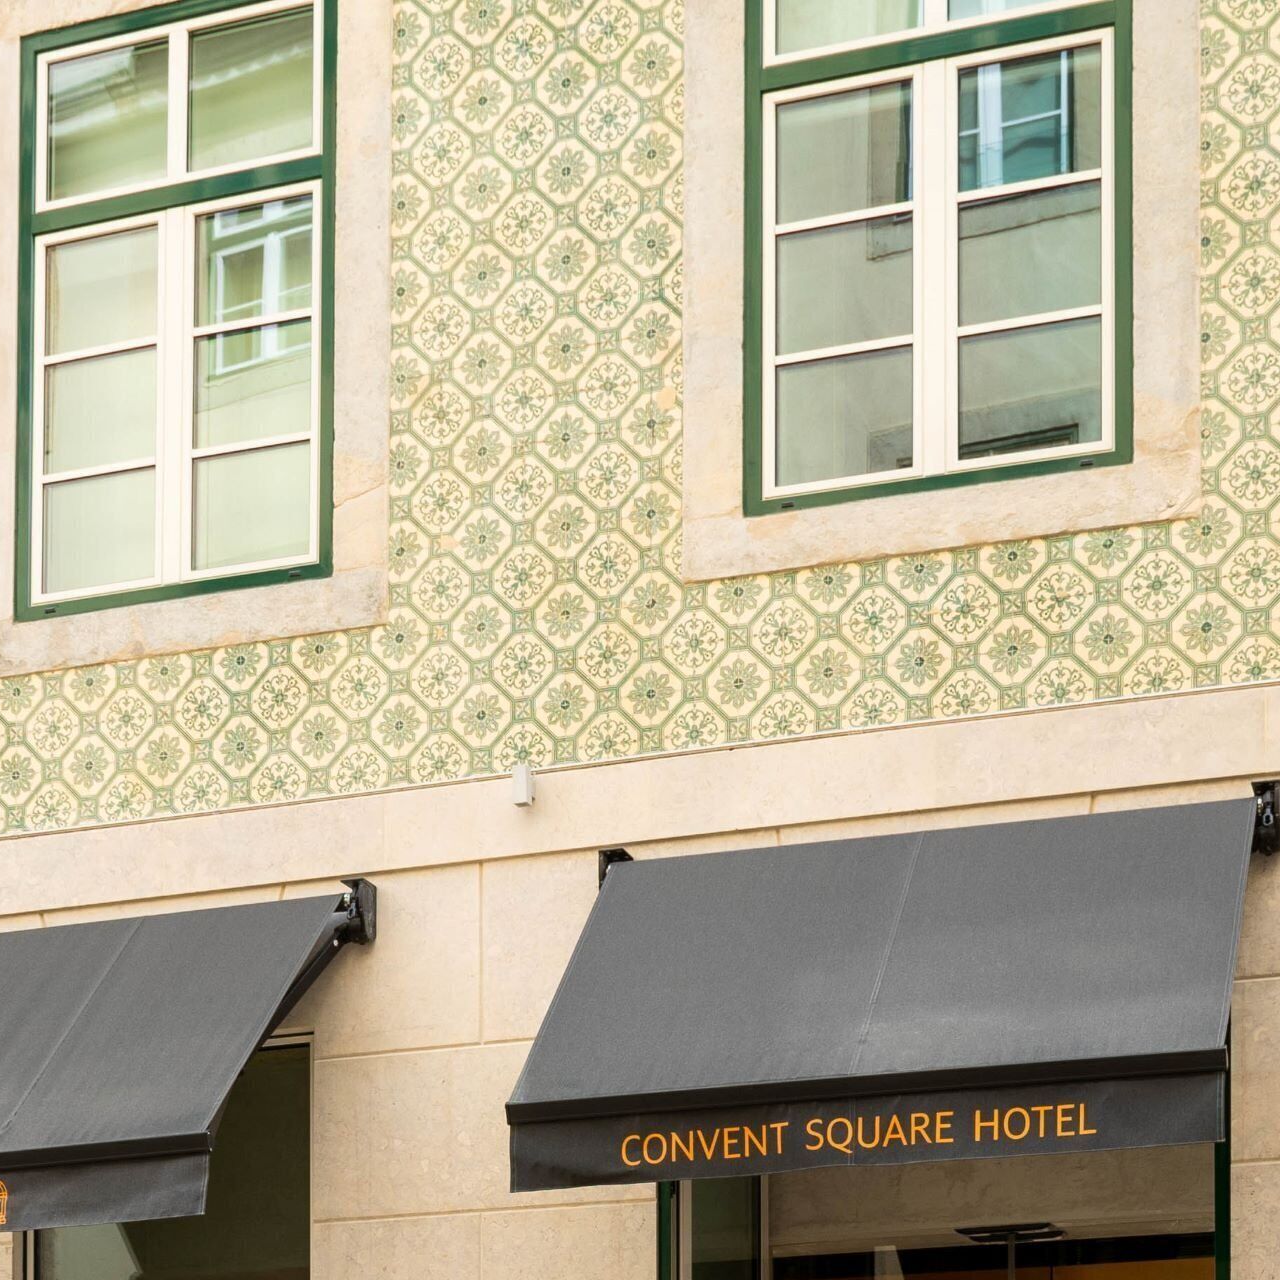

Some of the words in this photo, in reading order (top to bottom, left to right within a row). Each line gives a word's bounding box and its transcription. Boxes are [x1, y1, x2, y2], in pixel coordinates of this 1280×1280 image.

[621, 1122, 789, 1167] CONVENT
[805, 1110, 954, 1154] SQUARE
[974, 1103, 1096, 1141] HOTEL
